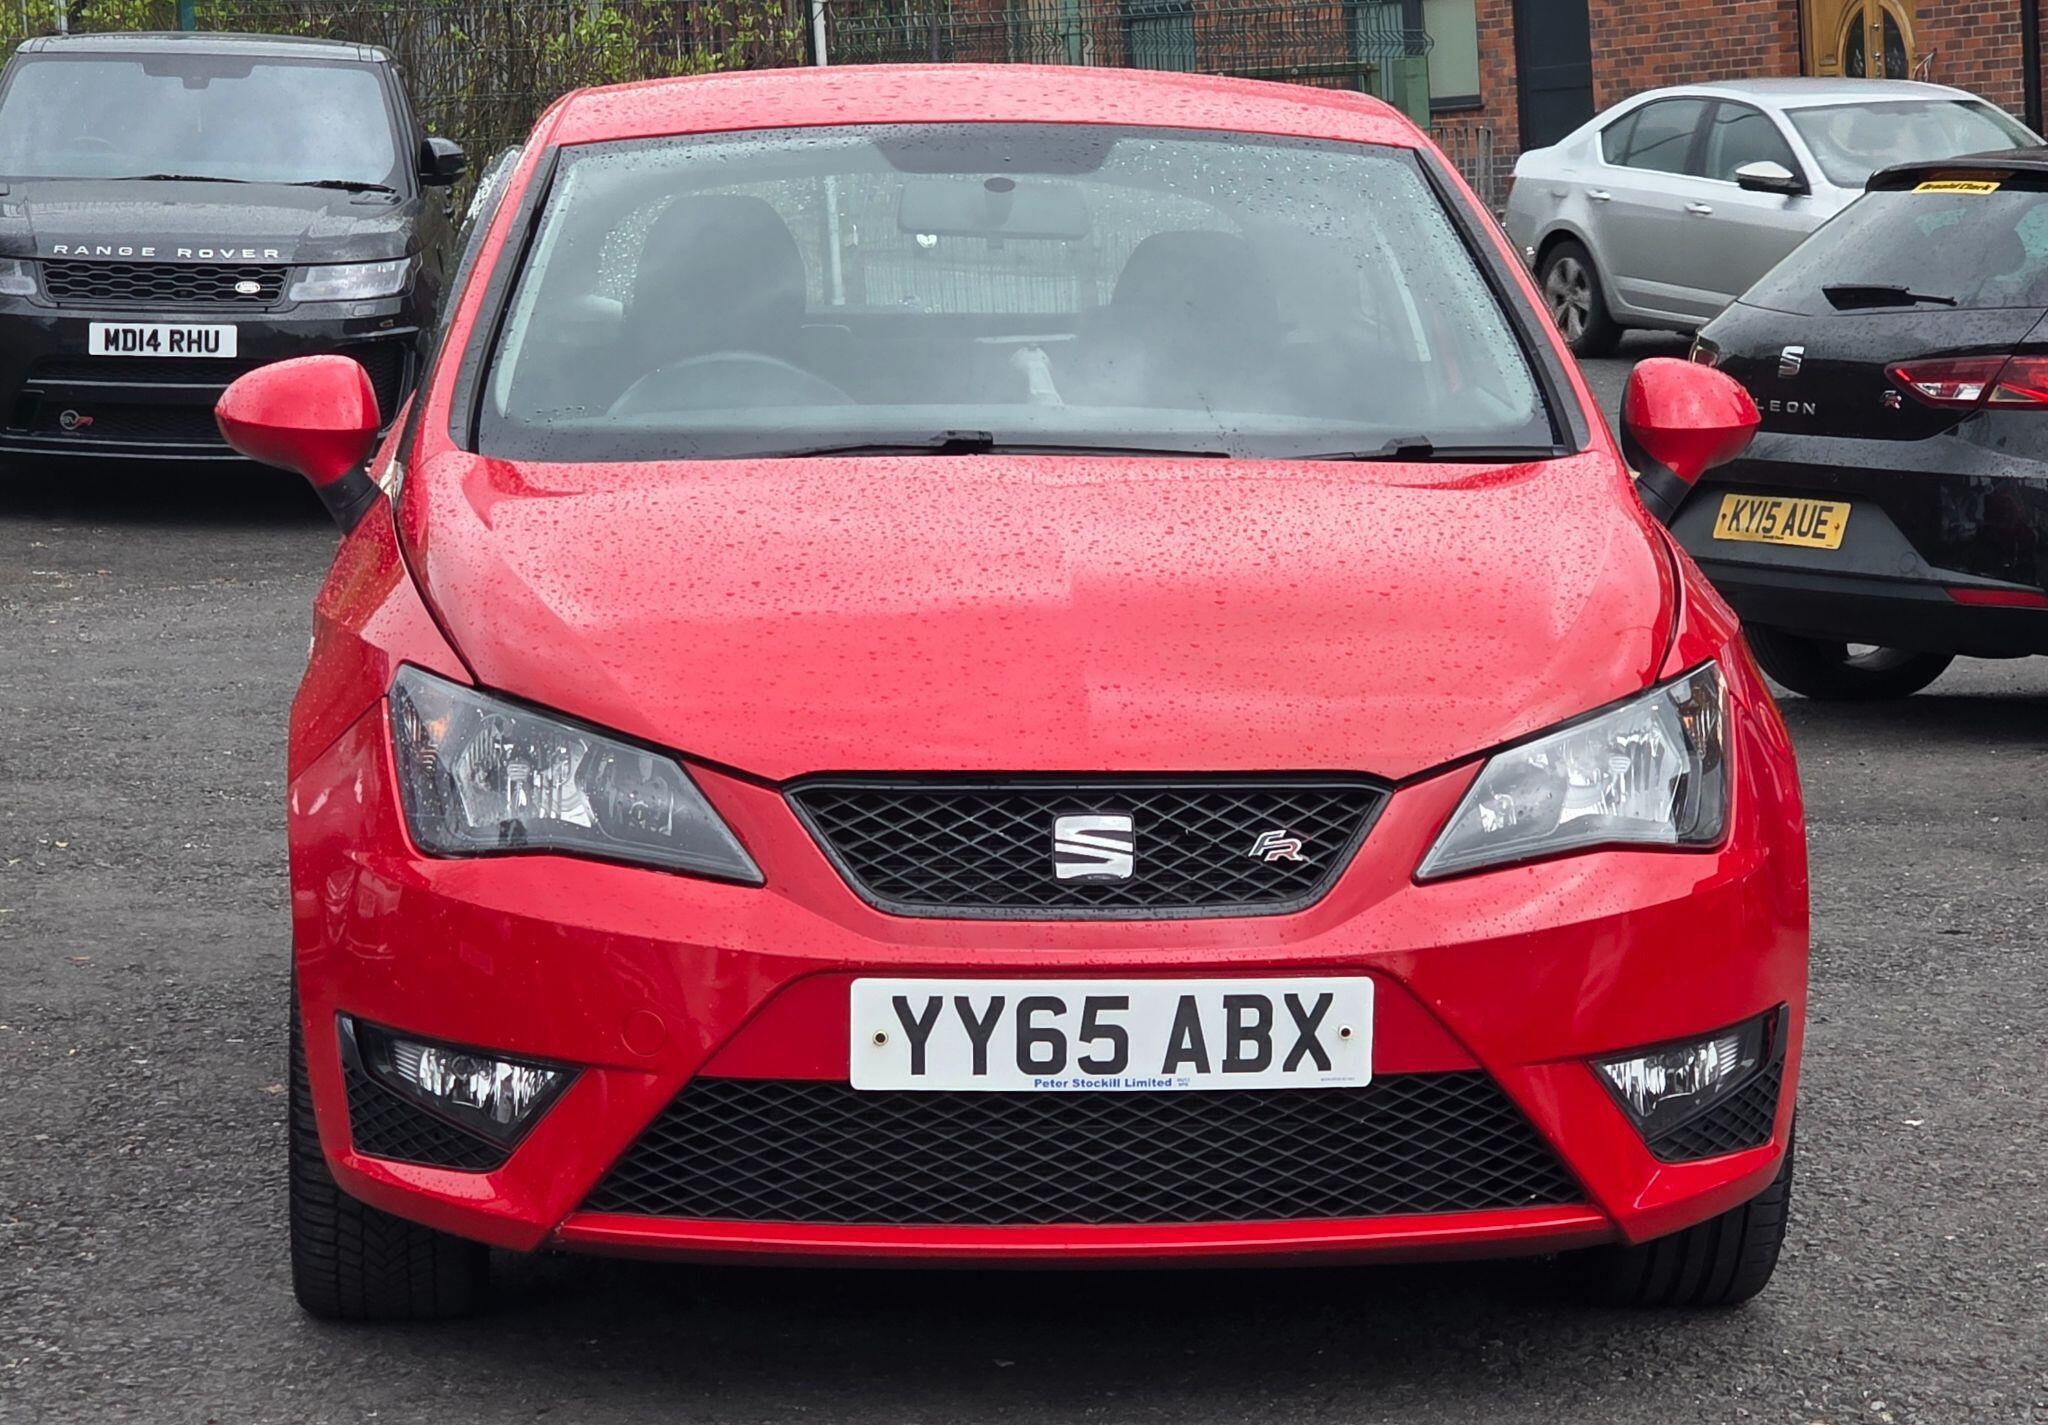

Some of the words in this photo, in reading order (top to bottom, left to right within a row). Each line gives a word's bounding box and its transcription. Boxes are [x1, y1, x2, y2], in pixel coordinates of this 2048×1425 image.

[53, 245, 156, 257] RANGE
[177, 248, 280, 259] ROVER
[104, 328, 161, 351] MD14
[169, 329, 220, 353] RHU
[1755, 398, 1816, 415] LEON
[1727, 499, 1782, 534] KY15
[1780, 502, 1834, 540] AUE
[892, 995, 1130, 1076] YY65
[1161, 992, 1334, 1075] ABX
[1034, 1078, 1068, 1088] Peter
[1072, 1078, 1120, 1088] Stockill
[1124, 1077, 1172, 1088] Limited
